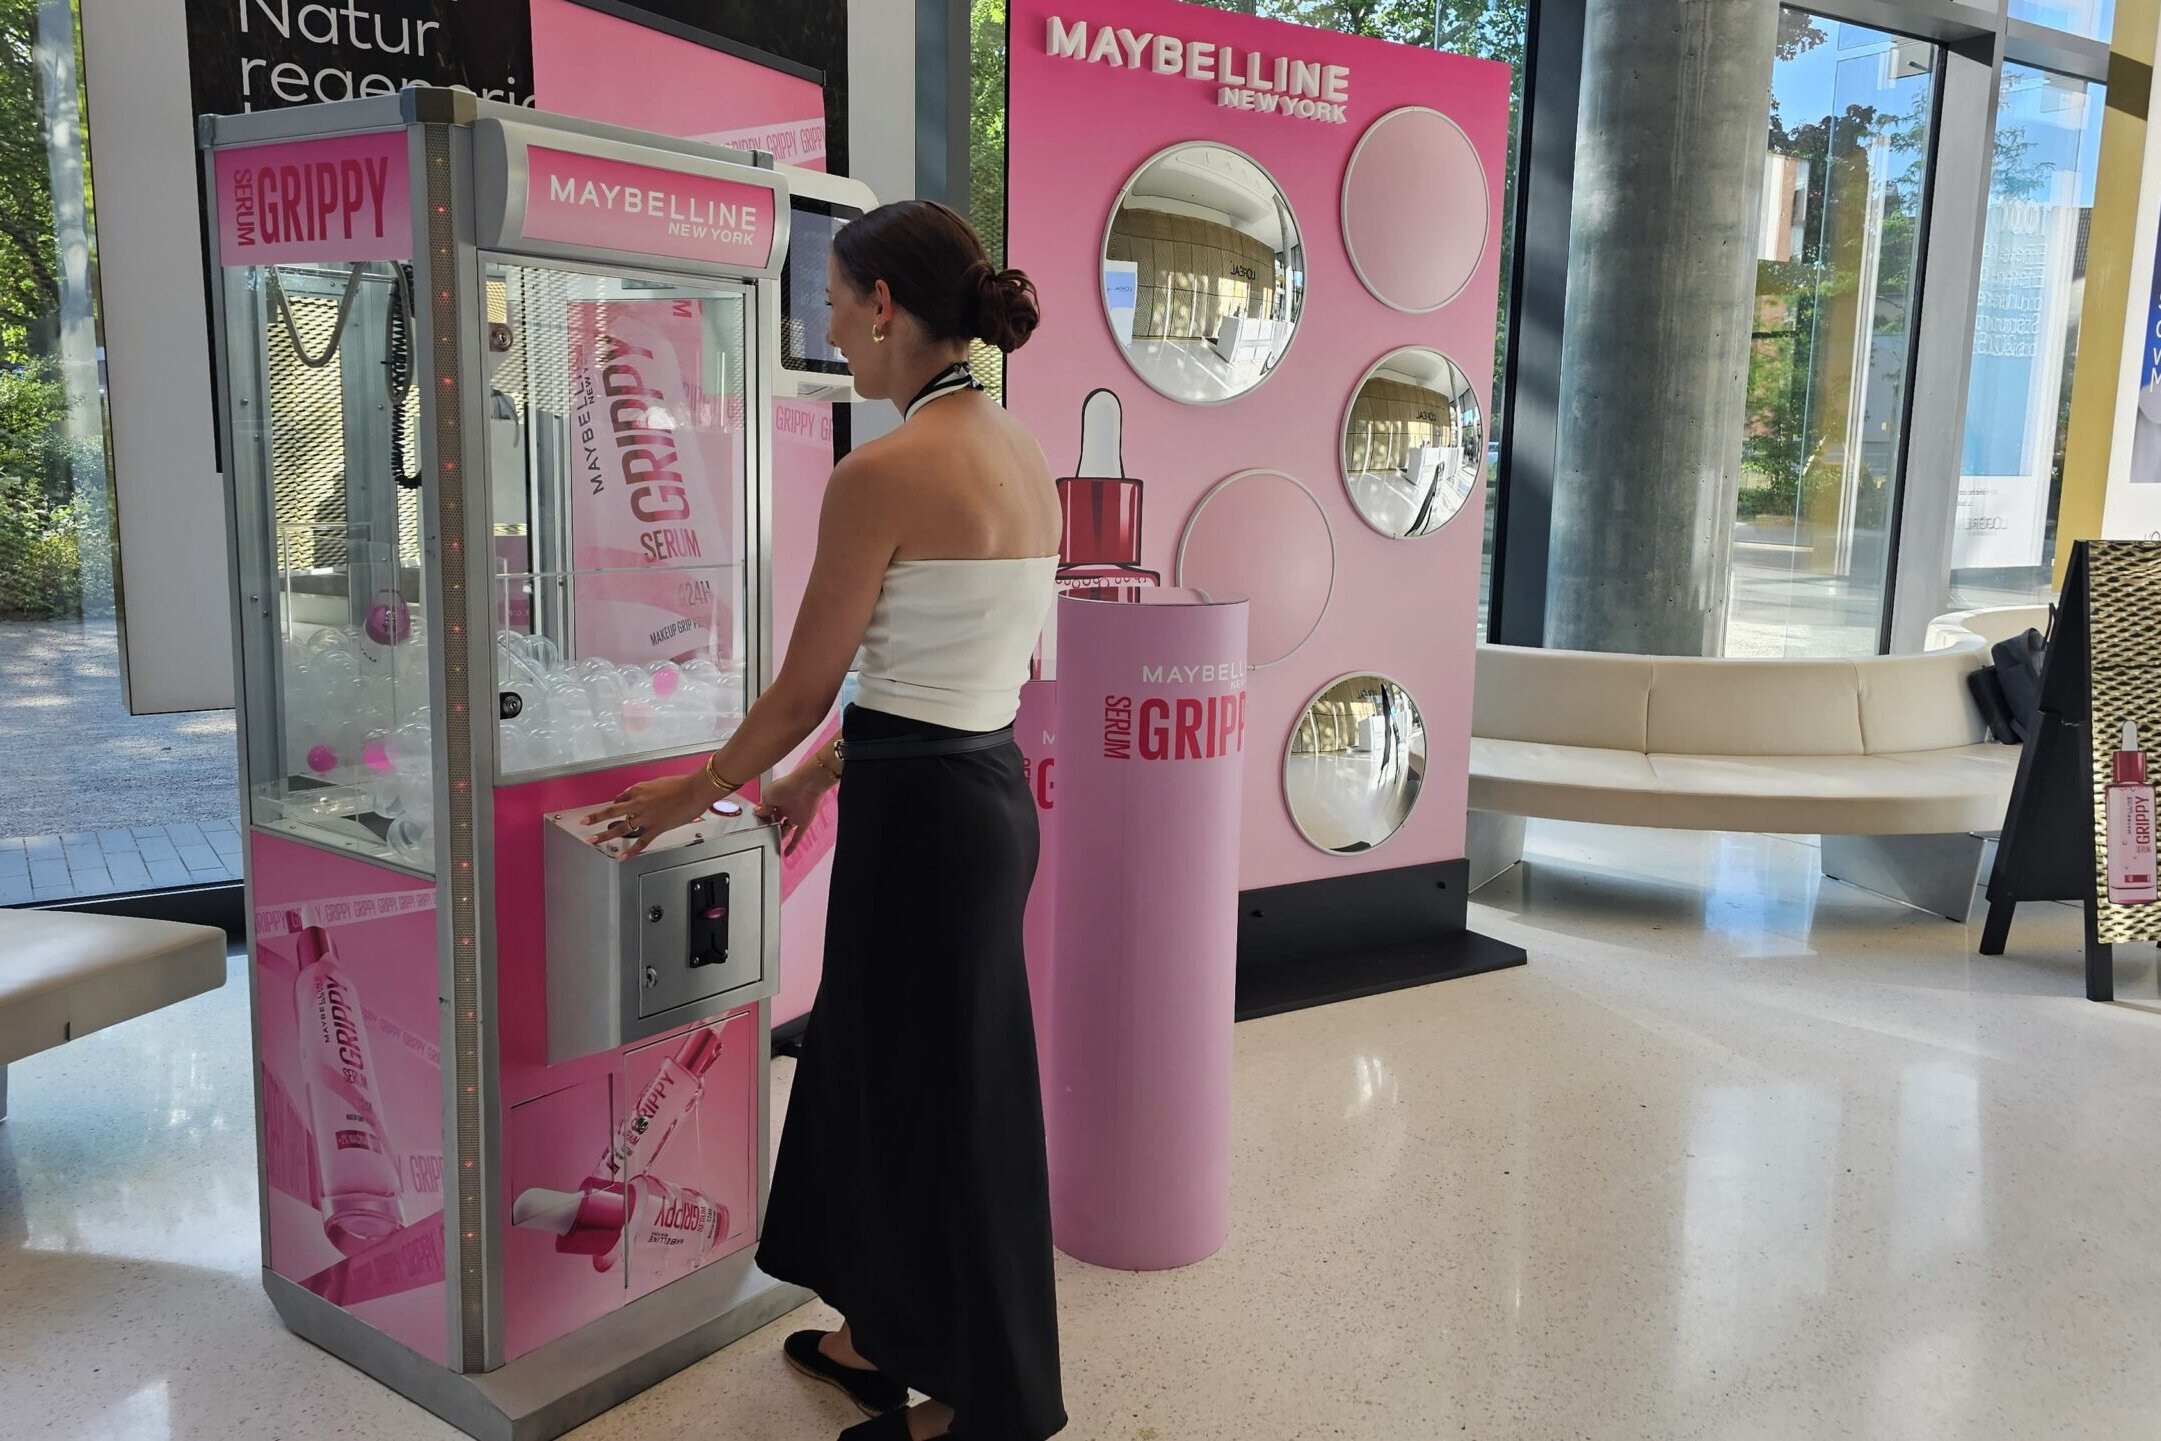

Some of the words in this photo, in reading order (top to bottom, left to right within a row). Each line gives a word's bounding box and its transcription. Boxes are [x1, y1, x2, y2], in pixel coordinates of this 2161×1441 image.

[239, 0, 440, 57] Natur
[1045, 15, 1350, 102] MAYBELLINE
[1217, 86, 1280, 113] NEW
[1279, 96, 1348, 124] YORK
[767, 130, 798, 161] GRIPPY
[234, 169, 256, 247] SERUM
[257, 156, 389, 245] GRIPPY
[550, 174, 757, 231] MAYBELLINE
[668, 222, 707, 238] NEW
[710, 229, 754, 246] YORK
[596, 334, 691, 523] GRIPPY
[776, 406, 815, 438] GRIPPY
[640, 528, 701, 563] SERUM
[649, 621, 677, 647] MAKEUP
[1104, 695, 1132, 760] SERUM
[2136, 796, 2151, 845] GRIPPY
[255, 910, 287, 934] RIPPY
[325, 902, 350, 922] GRIPPY
[325, 973, 364, 1070] GRIPPY
[638, 1070, 675, 1119] RIPPY
[654, 1195, 700, 1231] GRIPPY
